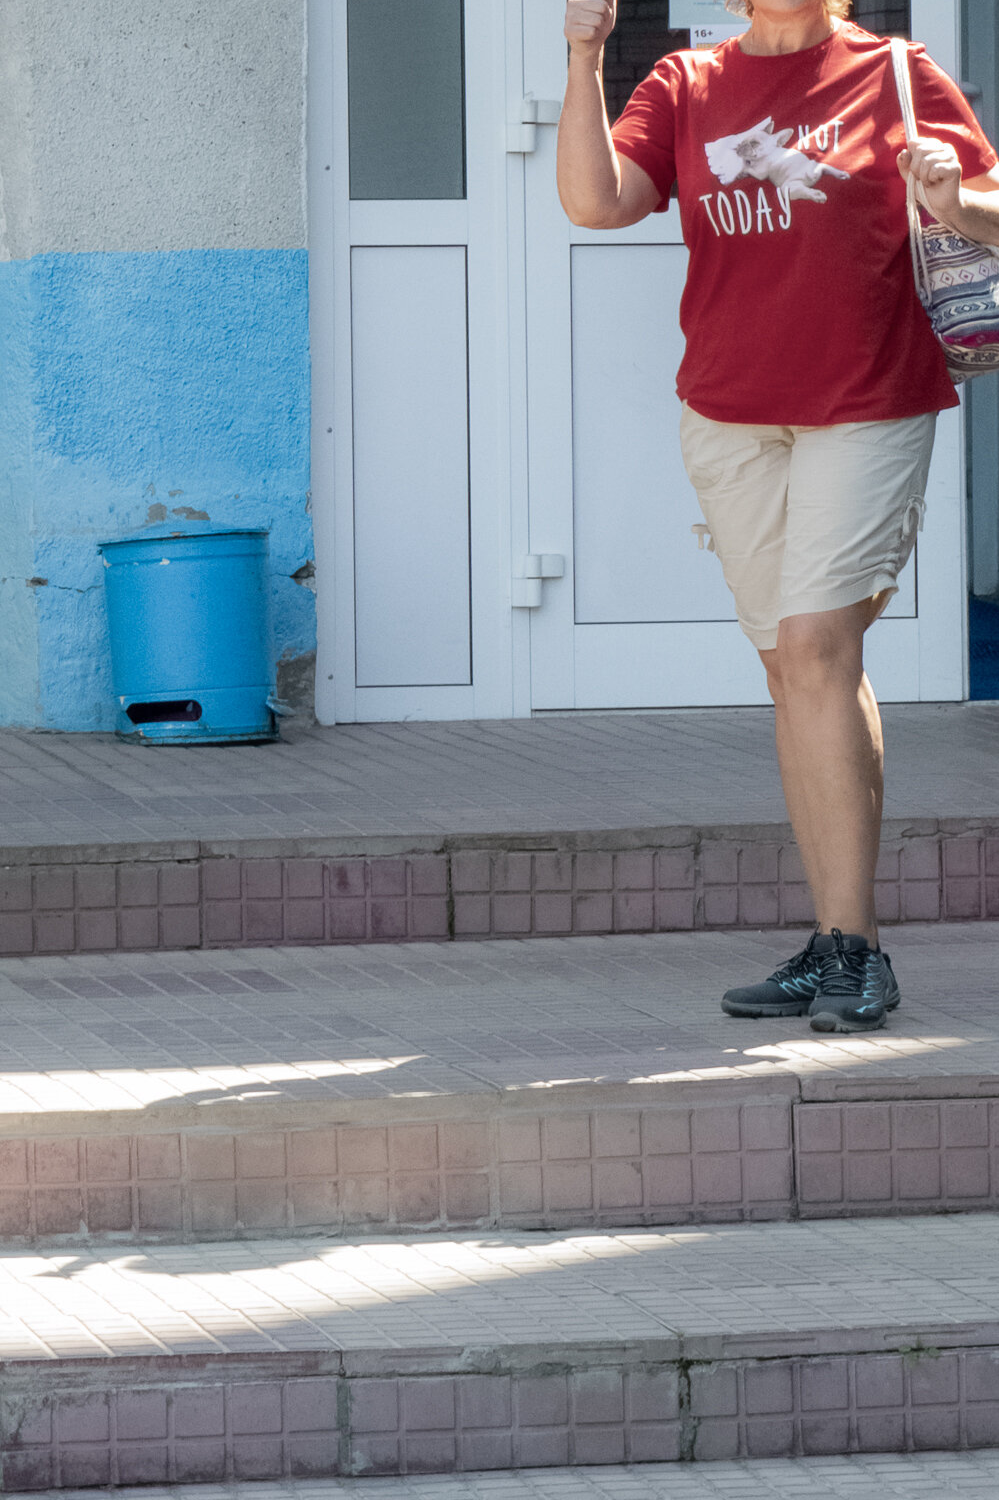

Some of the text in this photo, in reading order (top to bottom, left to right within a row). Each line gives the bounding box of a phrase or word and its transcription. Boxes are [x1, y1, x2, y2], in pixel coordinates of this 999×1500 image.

[694, 29, 713, 38] 16+
[797, 120, 844, 153] NOT
[699, 186, 792, 237] TODAY
